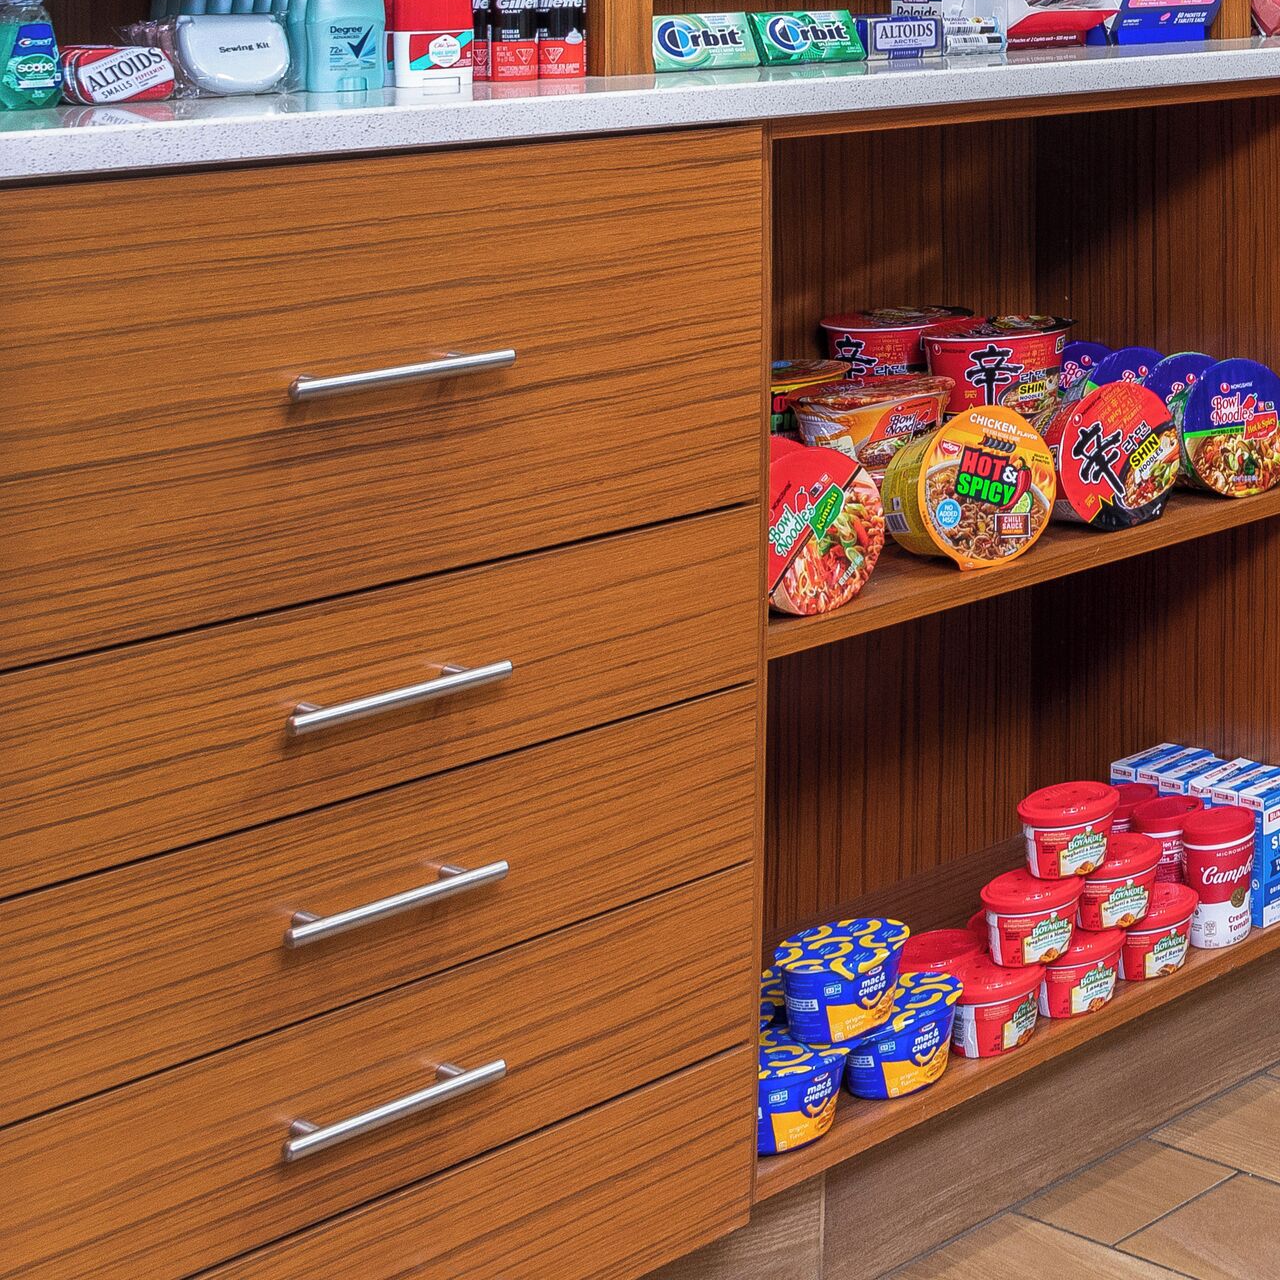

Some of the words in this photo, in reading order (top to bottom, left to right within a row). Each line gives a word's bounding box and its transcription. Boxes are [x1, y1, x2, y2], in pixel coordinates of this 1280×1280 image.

[330, 25, 363, 37] Degree
[657, 20, 743, 58] Orbit
[768, 17, 848, 52] Orbit
[880, 22, 933, 39] ALTOIDS
[219, 43, 254, 54] Sewing
[256, 42, 270, 50] Kit
[17, 61, 54, 75] scope
[87, 48, 164, 92] ALTOIDS
[102, 80, 133, 100] SMALLS
[1020, 382, 1045, 395] SHIN
[1020, 393, 1044, 401] NOODLES
[1212, 392, 1240, 409] Bowl
[970, 413, 1017, 433] CHICKEN
[1018, 430, 1038, 440] FLAVOR
[1211, 407, 1254, 425] Noodles
[1072, 421, 1126, 497] 辛
[1130, 437, 1160, 468] SHIN
[1138, 447, 1164, 473] NOODLES
[961, 450, 1006, 481] HOT
[1003, 467, 1018, 483] &
[957, 473, 1015, 505] SPICY
[769, 503, 795, 543] Bowl
[816, 493, 838, 529] Kimchi
[775, 503, 816, 557] Noodles
